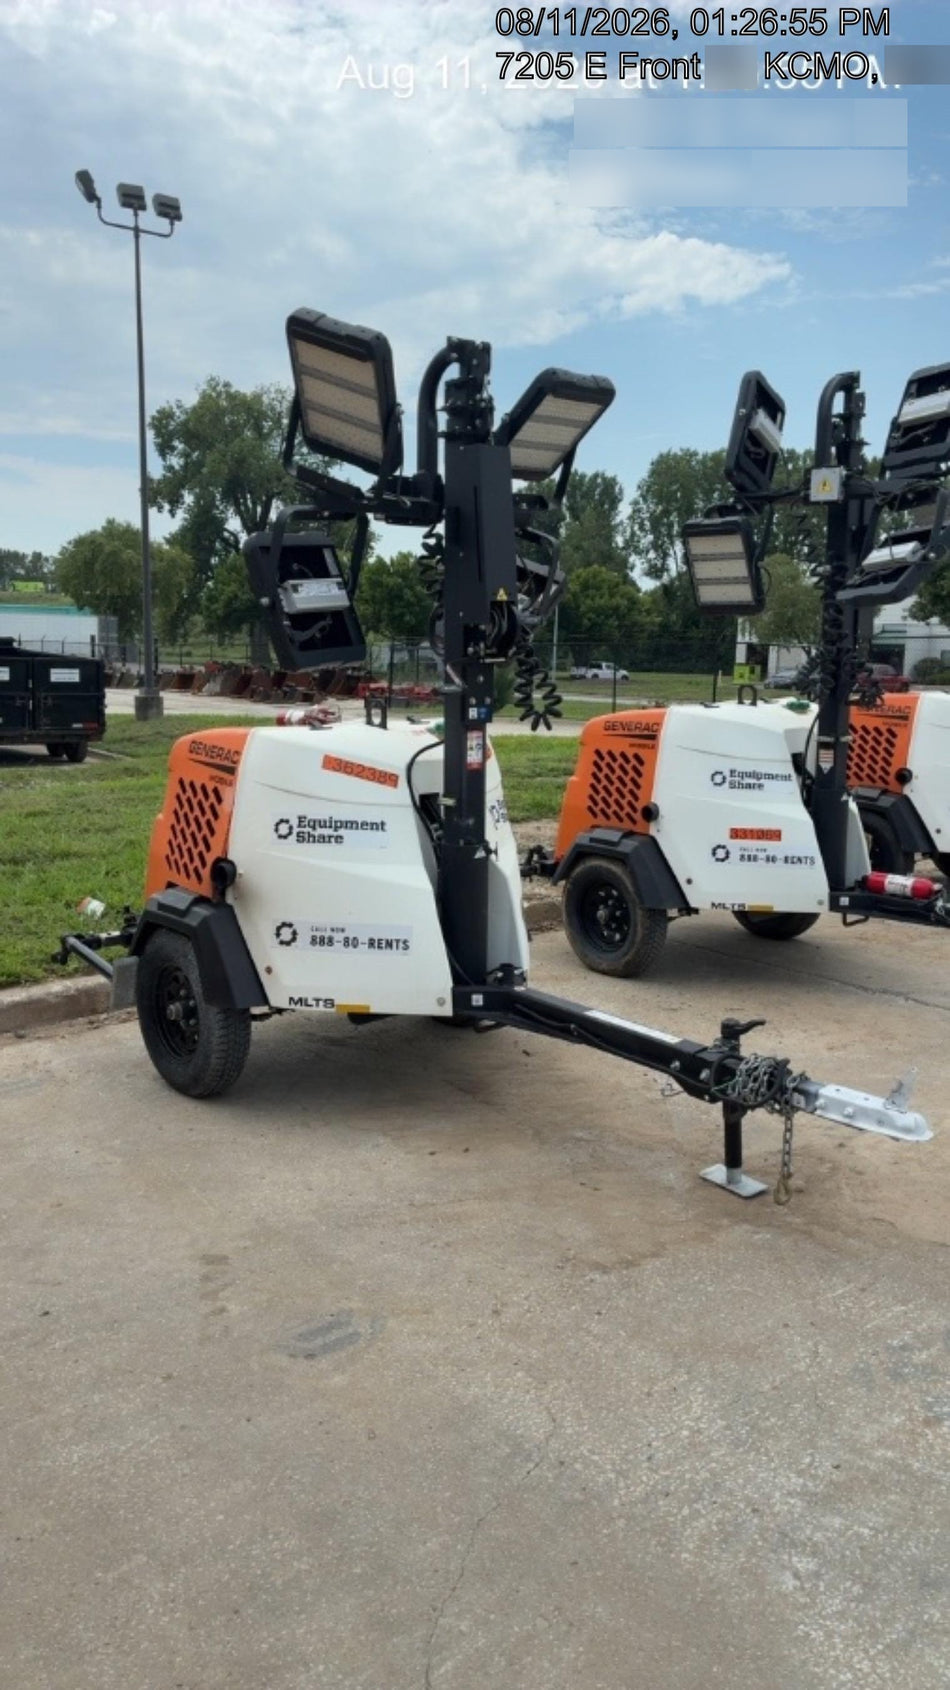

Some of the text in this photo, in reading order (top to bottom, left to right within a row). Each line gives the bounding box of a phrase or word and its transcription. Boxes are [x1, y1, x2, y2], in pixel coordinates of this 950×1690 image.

[604, 720, 660, 733] GENERAC
[189, 740, 243, 765] GENERAC
[728, 769, 793, 782] Equipment
[728, 780, 765, 790] Share
[296, 815, 388, 832] Equipment
[296, 831, 344, 844] Share
[309, 934, 410, 951] 888-80-RENTS
